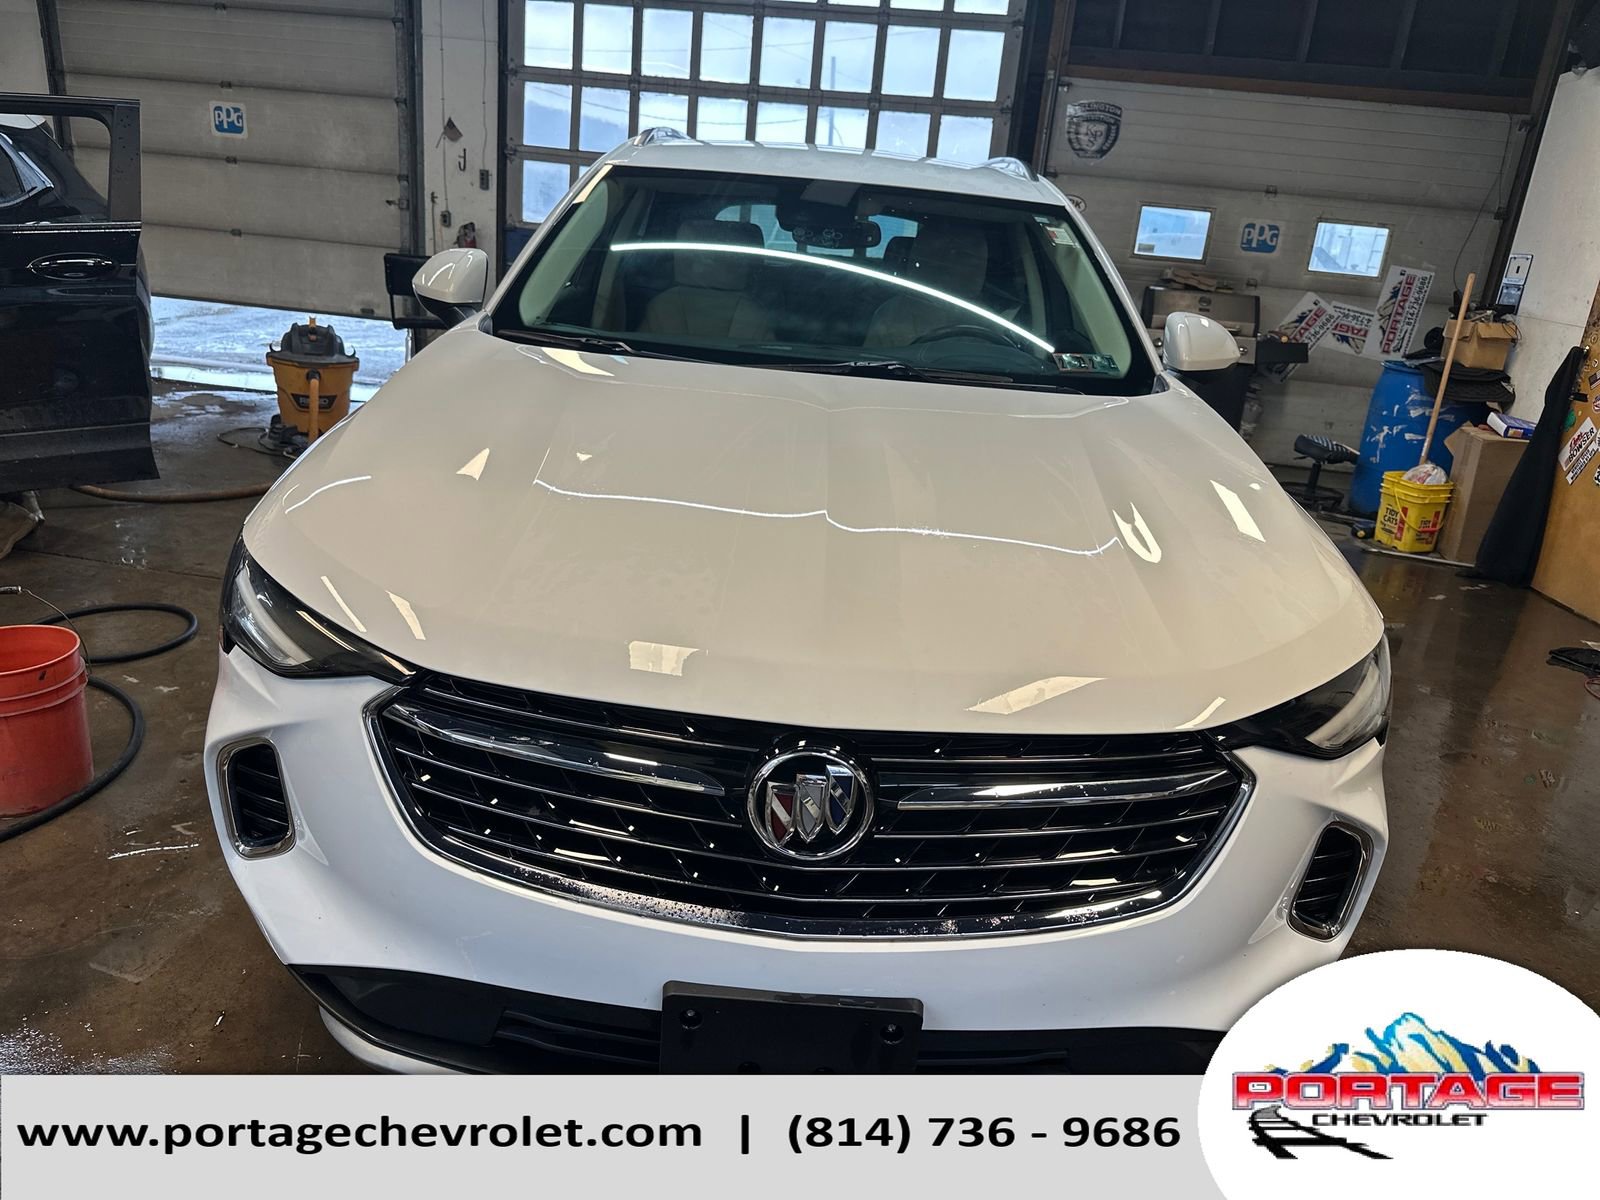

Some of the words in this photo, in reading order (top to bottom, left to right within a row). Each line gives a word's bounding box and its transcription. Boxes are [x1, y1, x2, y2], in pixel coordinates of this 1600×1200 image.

[214, 105, 243, 128] PPG
[1243, 223, 1279, 248] PPG
[1293, 305, 1327, 342] TAGE
[1382, 274, 1417, 353] PORTAGE
[1568, 427, 1594, 462] BOWSER
[1384, 514, 1398, 526] CATS
[1386, 507, 1399, 517] TIDY
